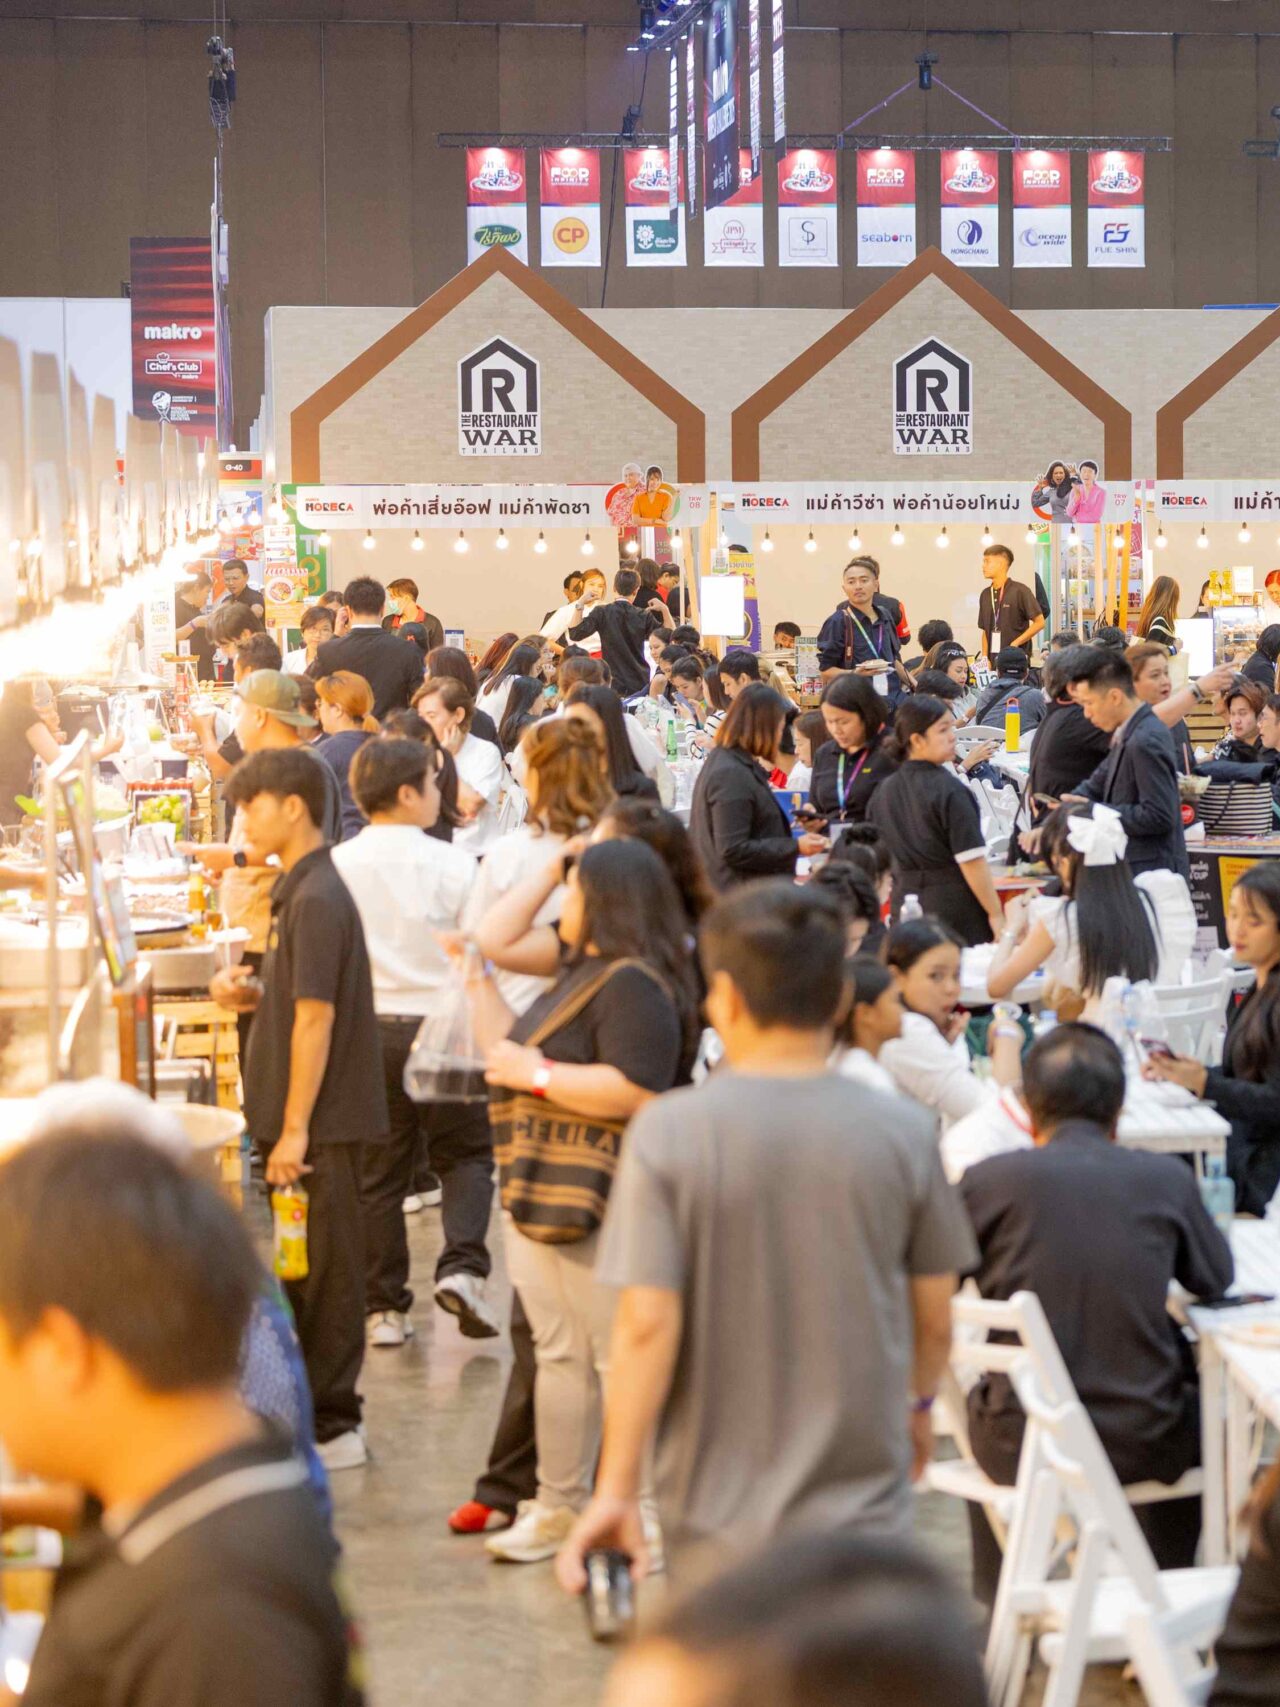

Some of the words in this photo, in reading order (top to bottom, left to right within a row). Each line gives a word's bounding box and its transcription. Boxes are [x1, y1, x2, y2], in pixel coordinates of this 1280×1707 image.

[550, 167, 590, 178] FOOD
[867, 168, 905, 178] FOOD
[1023, 169, 1061, 179] FOOD
[557, 228, 585, 243] CP
[861, 232, 913, 243] seaborn
[144, 323, 202, 340] makro
[149, 362, 177, 371] Chef's
[177, 362, 199, 371] Club
[482, 369, 516, 412] R
[916, 369, 949, 412] R
[461, 414, 471, 427] THE
[472, 414, 537, 427] RESTAURANT
[896, 413, 905, 427] THE
[906, 413, 969, 427] RESTAURANT
[462, 429, 538, 446] WAR
[896, 429, 969, 444] WAR
[305, 502, 354, 512] HORECA
[500, 498, 590, 515] แม่ค้าพัดชา
[742, 497, 789, 507] HORECA
[806, 493, 884, 510] แม่ค้าวีซ่า
[893, 493, 1020, 510] พ่อค้าน้อยโหน่ง
[1162, 496, 1207, 505] HORECA
